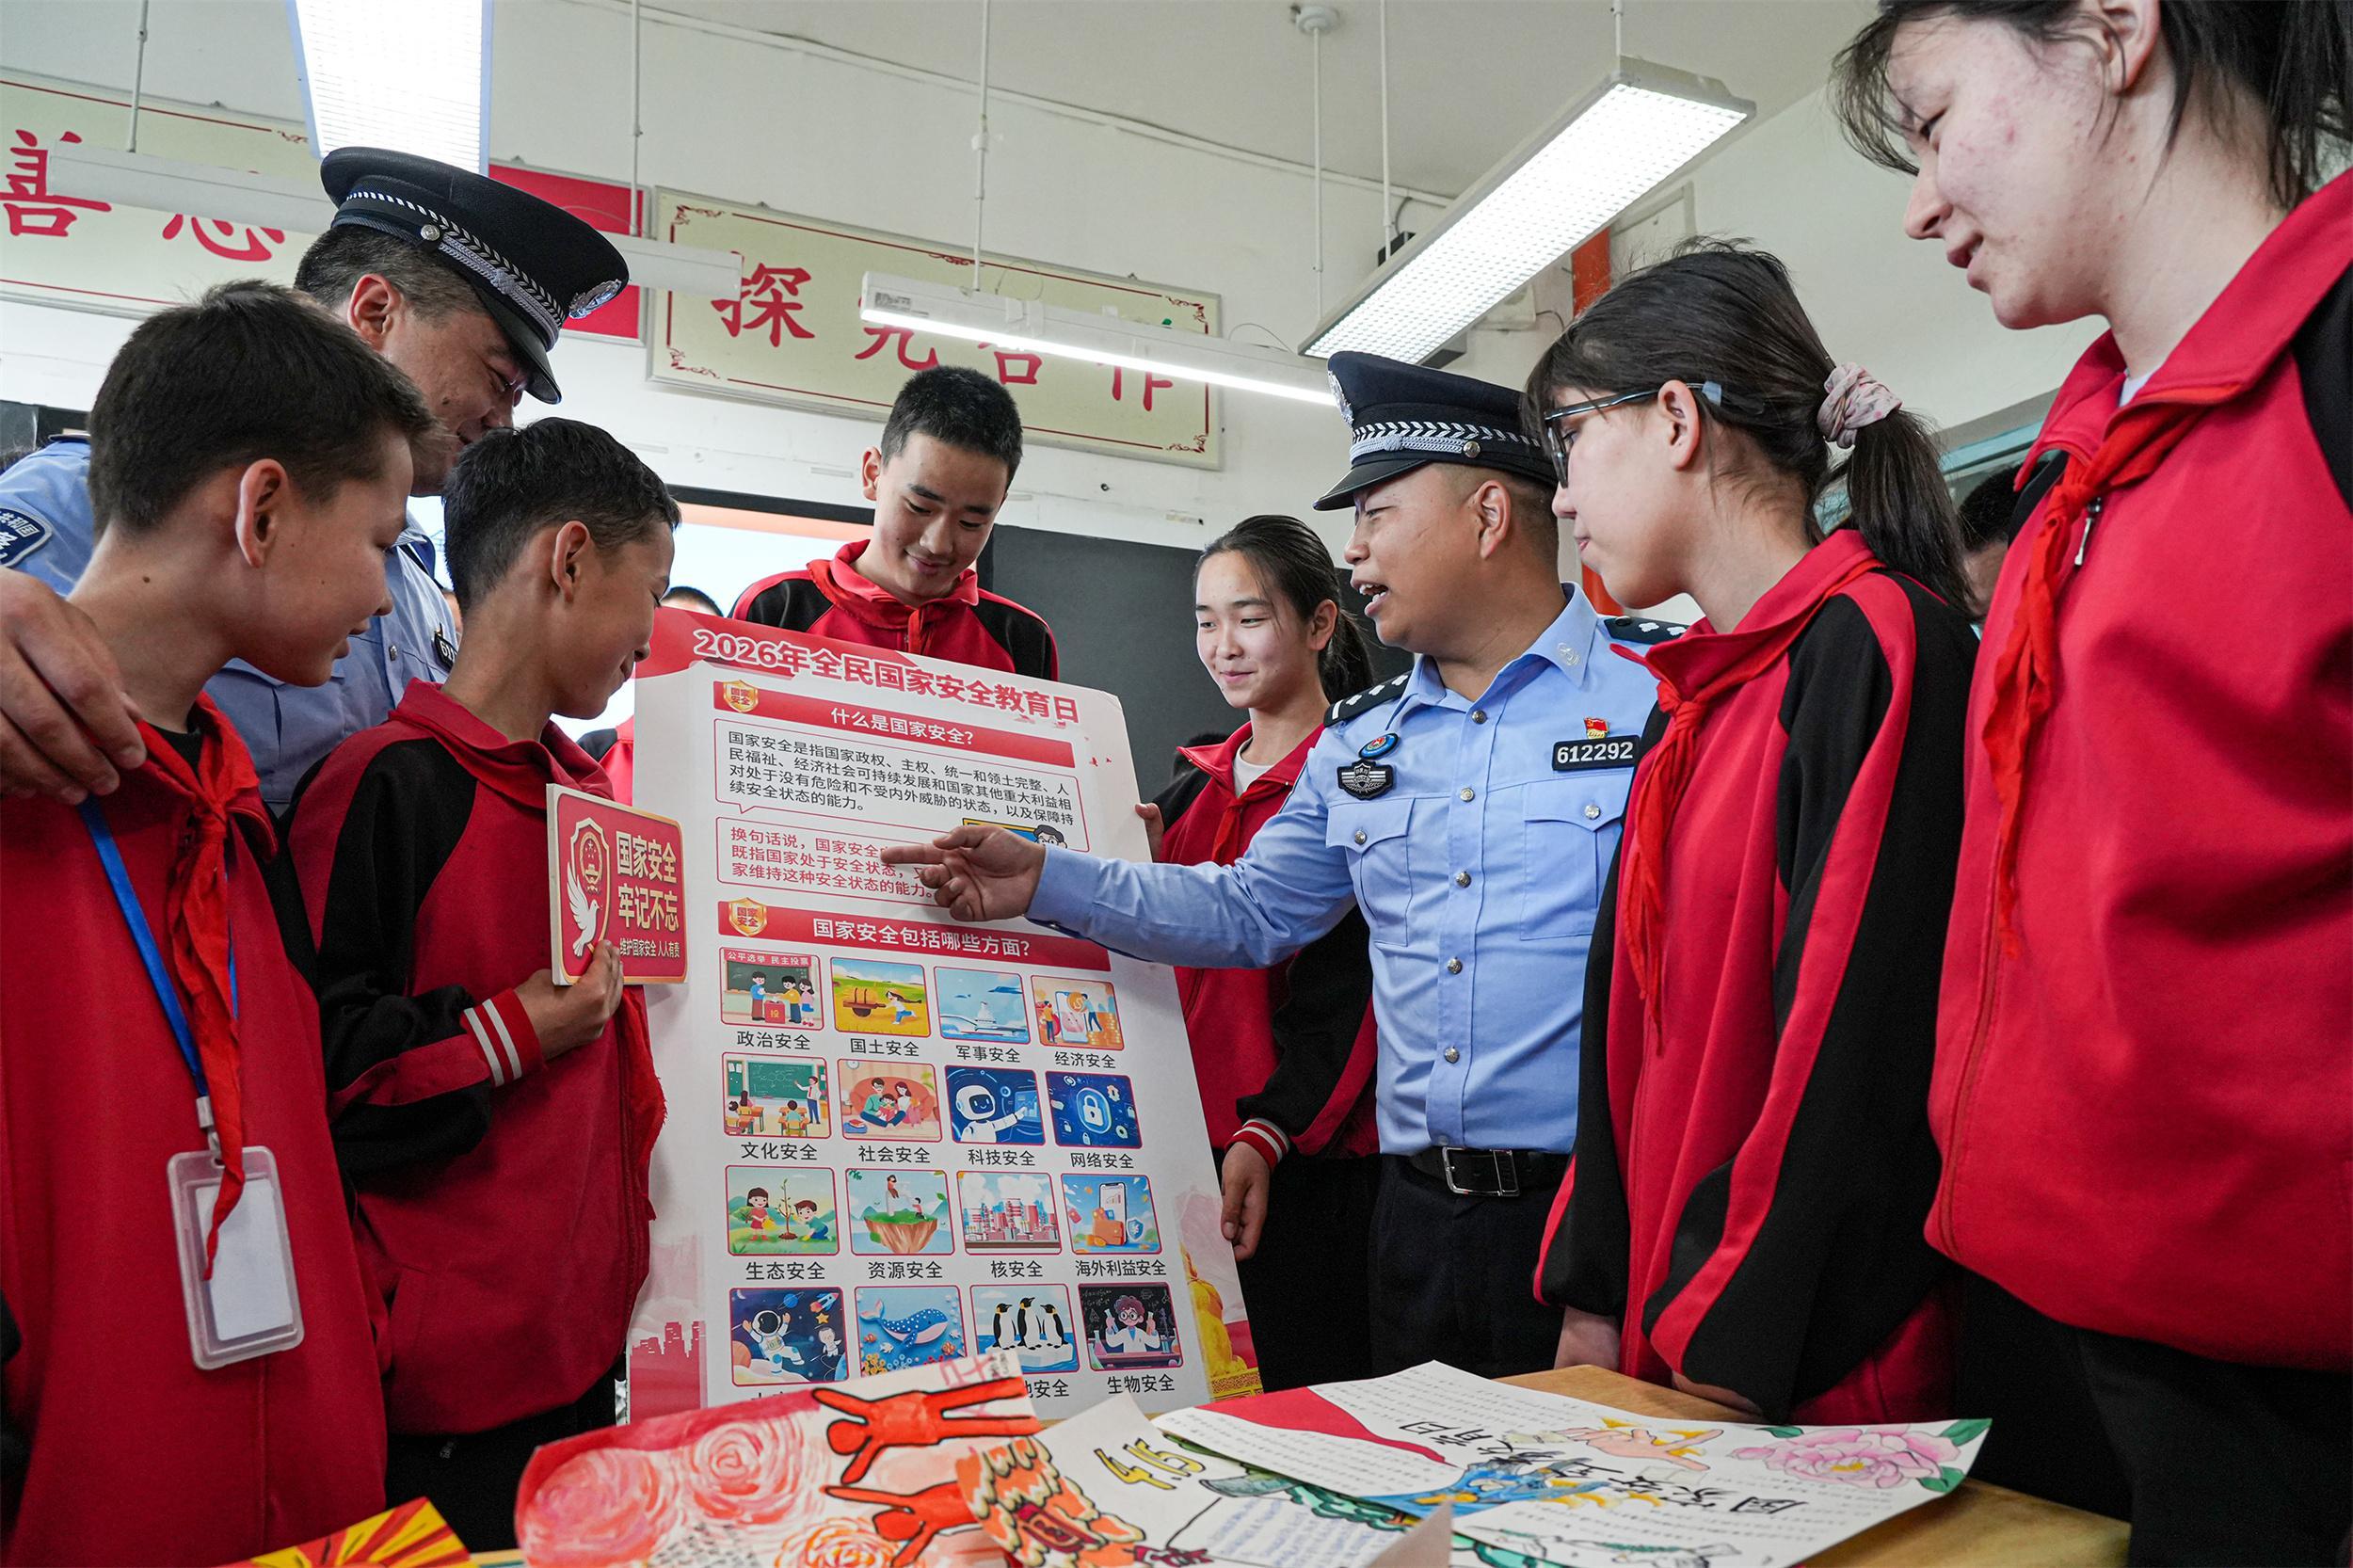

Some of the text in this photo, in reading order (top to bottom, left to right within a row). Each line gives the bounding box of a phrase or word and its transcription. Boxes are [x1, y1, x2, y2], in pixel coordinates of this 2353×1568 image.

[693, 629, 1080, 724] 2026年全民国家安全教育日
[830, 707, 973, 745] 什么是国家安全？
[1557, 741, 1634, 764] 612292
[728, 730, 1070, 796] 国家安全是指国家政权、主权、统一和领土完整、人
[729, 747, 1072, 811] 民福祉、经济社会可持续发展和国家其他重大利益相
[729, 764, 1074, 826] 对处于没有危险和不受内外威胁的状态，以及保障持
[729, 779, 864, 811] 续安全状态的能力。
[730, 826, 888, 858] 换句话说，国家安全
[616, 830, 677, 884] 国家安全
[731, 862, 934, 899] 家维持这种安全状态的能力。
[617, 884, 680, 932] 牢记不忘
[812, 918, 1031, 956] 国家安全包括哪些方面？
[728, 952, 808, 966] 公平选举 民主投票
[737, 1031, 811, 1050] 政治安全
[850, 1038, 920, 1058] 国土安全
[955, 1045, 1021, 1064] 军事安全
[1054, 1051, 1117, 1069] 经济安全
[741, 1142, 819, 1162] 文化安全
[857, 1145, 931, 1164] 社会安全
[968, 1148, 1036, 1167] 科技安全
[1070, 1151, 1134, 1169] 网络安全
[745, 1261, 826, 1281] 生态安全
[868, 1260, 943, 1280] 资源安全
[990, 1259, 1044, 1278] 核安全
[1074, 1259, 1167, 1277] 海外利益安全
[1106, 1373, 1176, 1394] 生物安全
